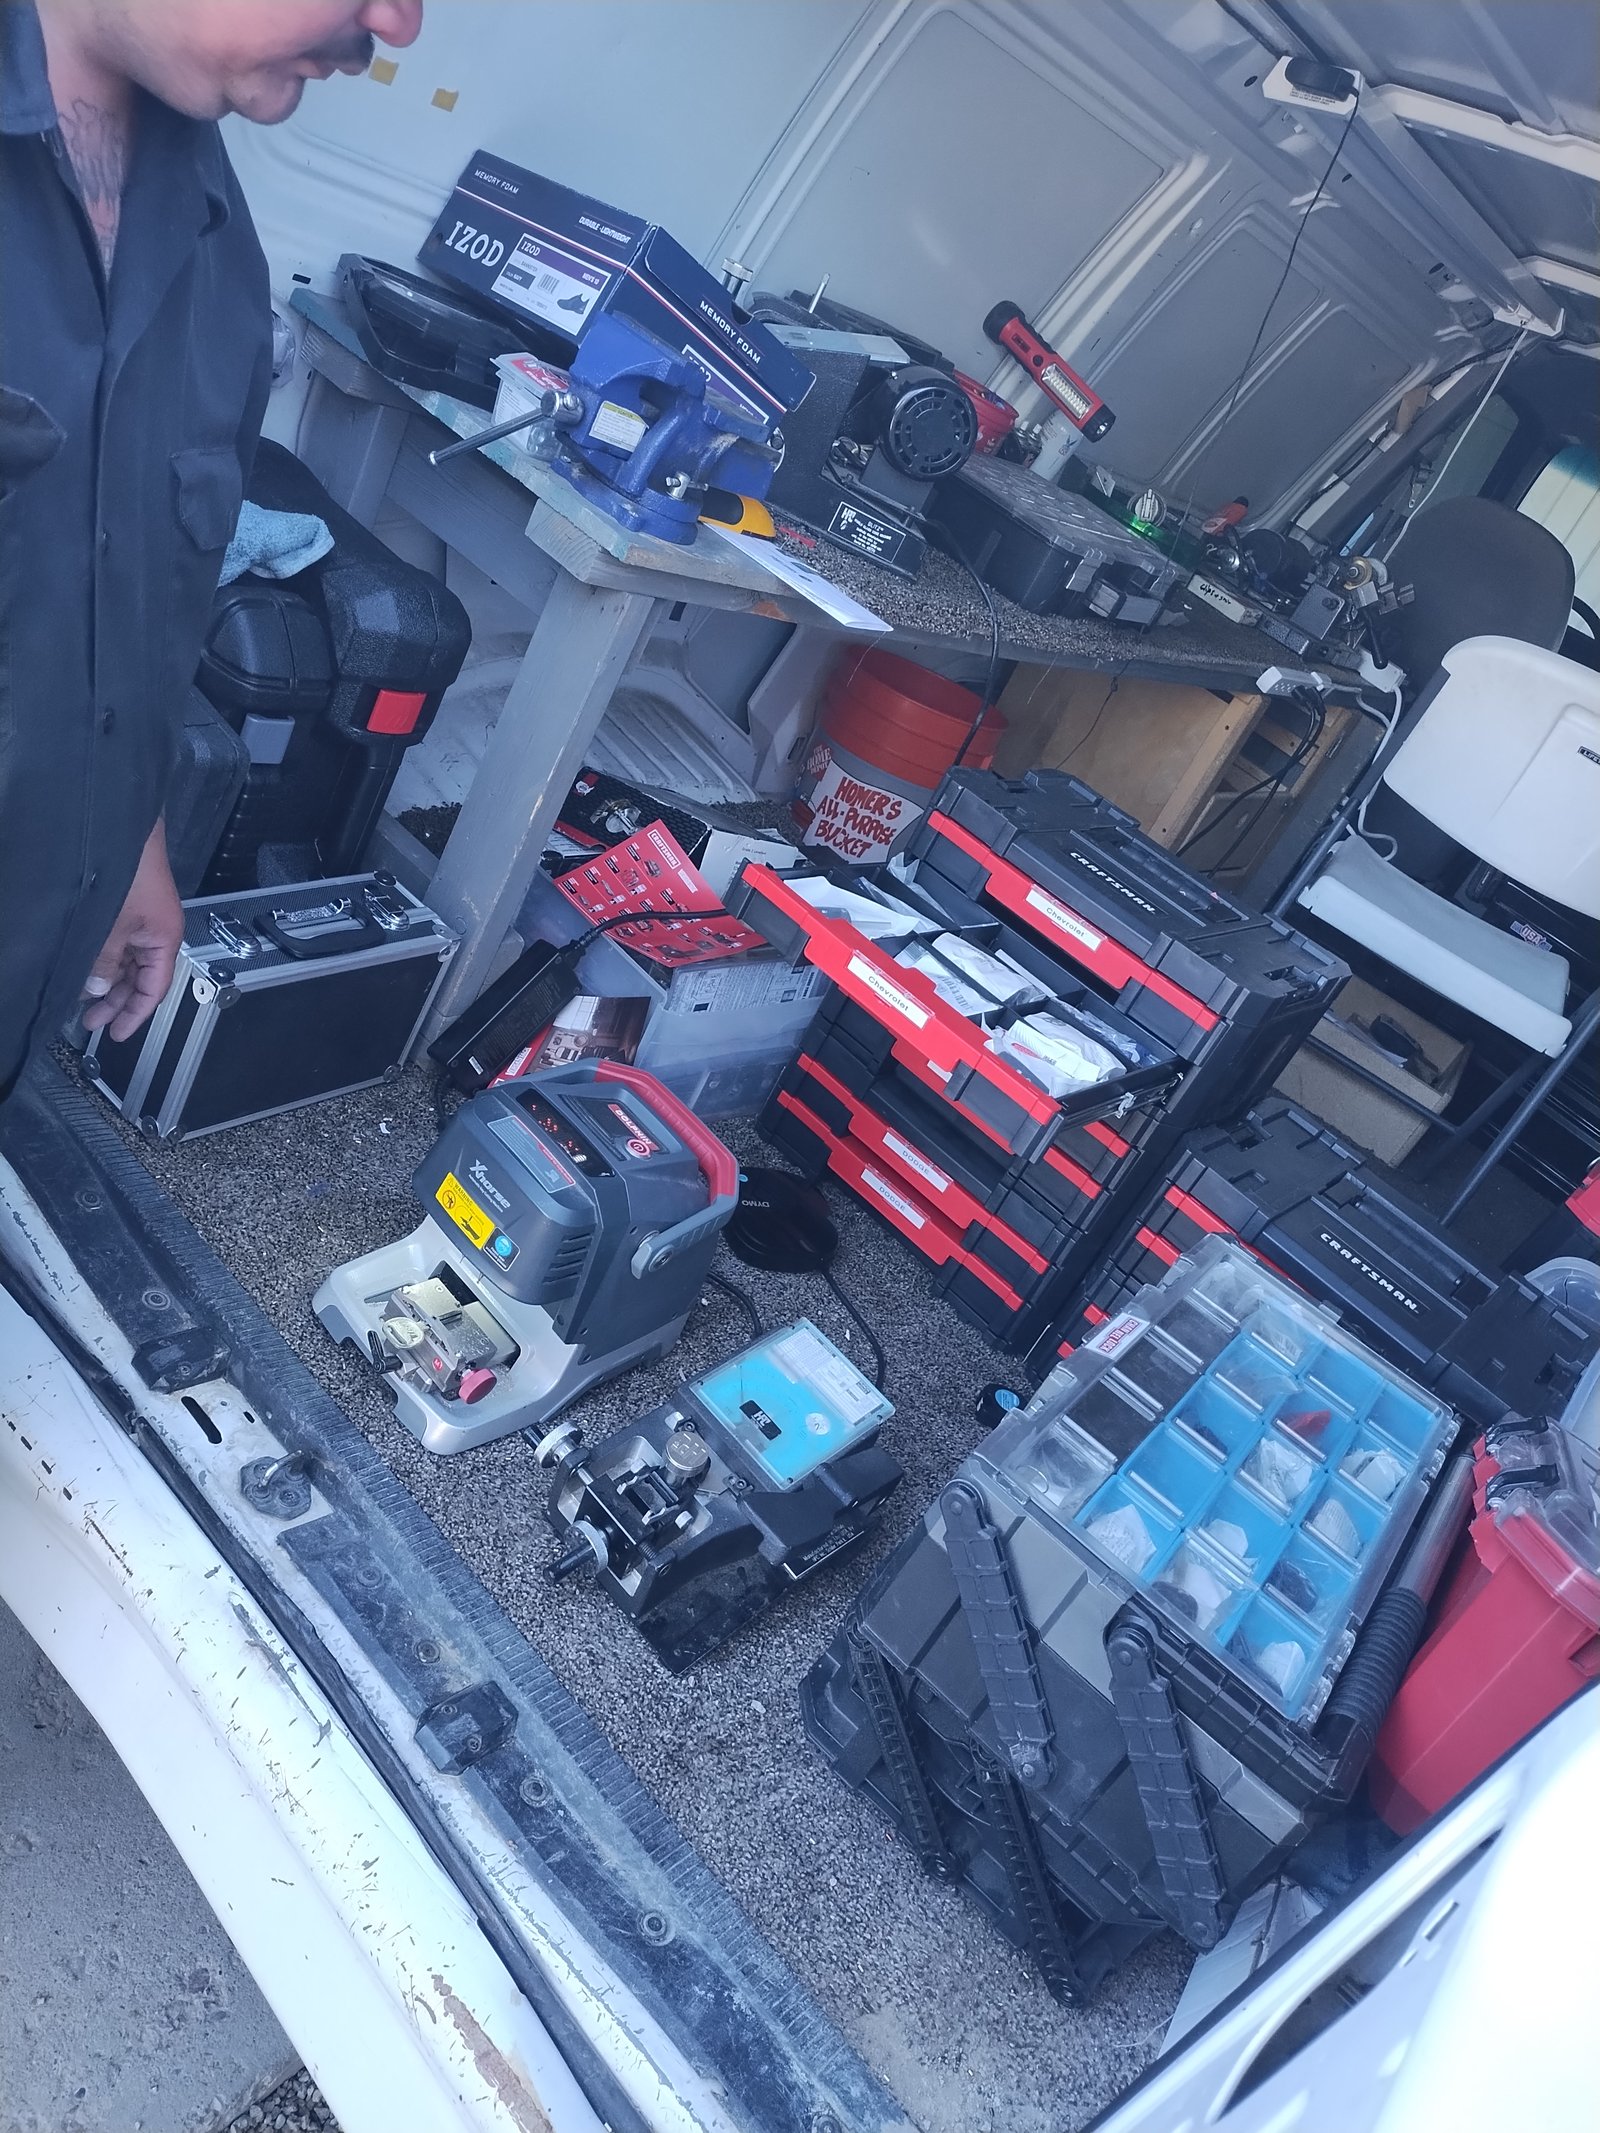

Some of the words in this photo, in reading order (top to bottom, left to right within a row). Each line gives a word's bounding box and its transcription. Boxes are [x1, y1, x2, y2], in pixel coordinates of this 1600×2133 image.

[475, 170, 501, 186] MEMORY
[501, 182, 519, 194] FOAM
[445, 221, 505, 267] IZOD
[521, 241, 540, 256] IZOD
[700, 301, 736, 338] MEMORY
[737, 337, 761, 364] FOAM
[834, 776, 902, 820] HOMER'S
[651, 832, 678, 867] CRAFTSMAN
[814, 819, 873, 858] BUCKET
[1070, 852, 1155, 913] CRAFTSMAN
[1046, 907, 1085, 937] Chevrolet
[1523, 926, 1541, 945] USA
[868, 976, 909, 1011] Chevrolet
[615, 1109, 652, 1145] DOLPHIN
[903, 1150, 929, 1175] DODGE
[469, 1159, 511, 1209] Xhorse
[879, 1187, 905, 1211] DODGE
[741, 1200, 770, 1208] DYMO
[1320, 1233, 1417, 1310] CRAFTSMAN
